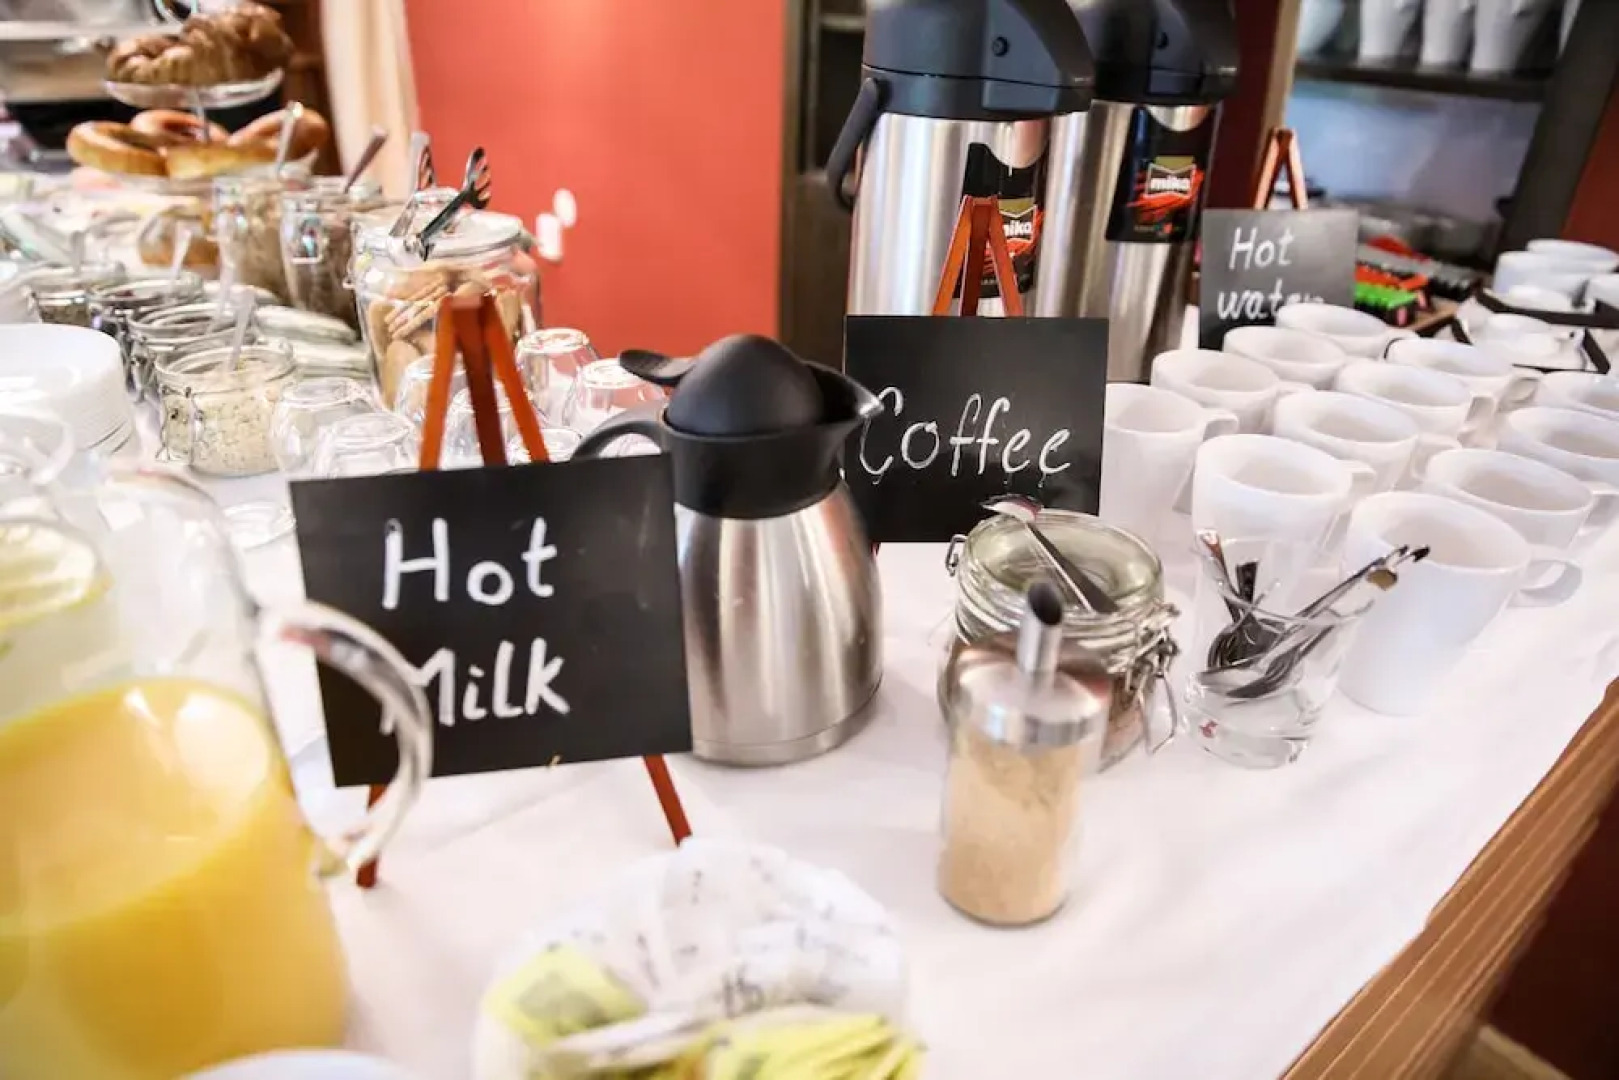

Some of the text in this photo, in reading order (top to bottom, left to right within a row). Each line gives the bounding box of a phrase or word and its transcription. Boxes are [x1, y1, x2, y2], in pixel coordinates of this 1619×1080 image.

[1229, 217, 1294, 270] Hot
[859, 386, 1071, 477] Coffee
[382, 517, 557, 611] Hot
